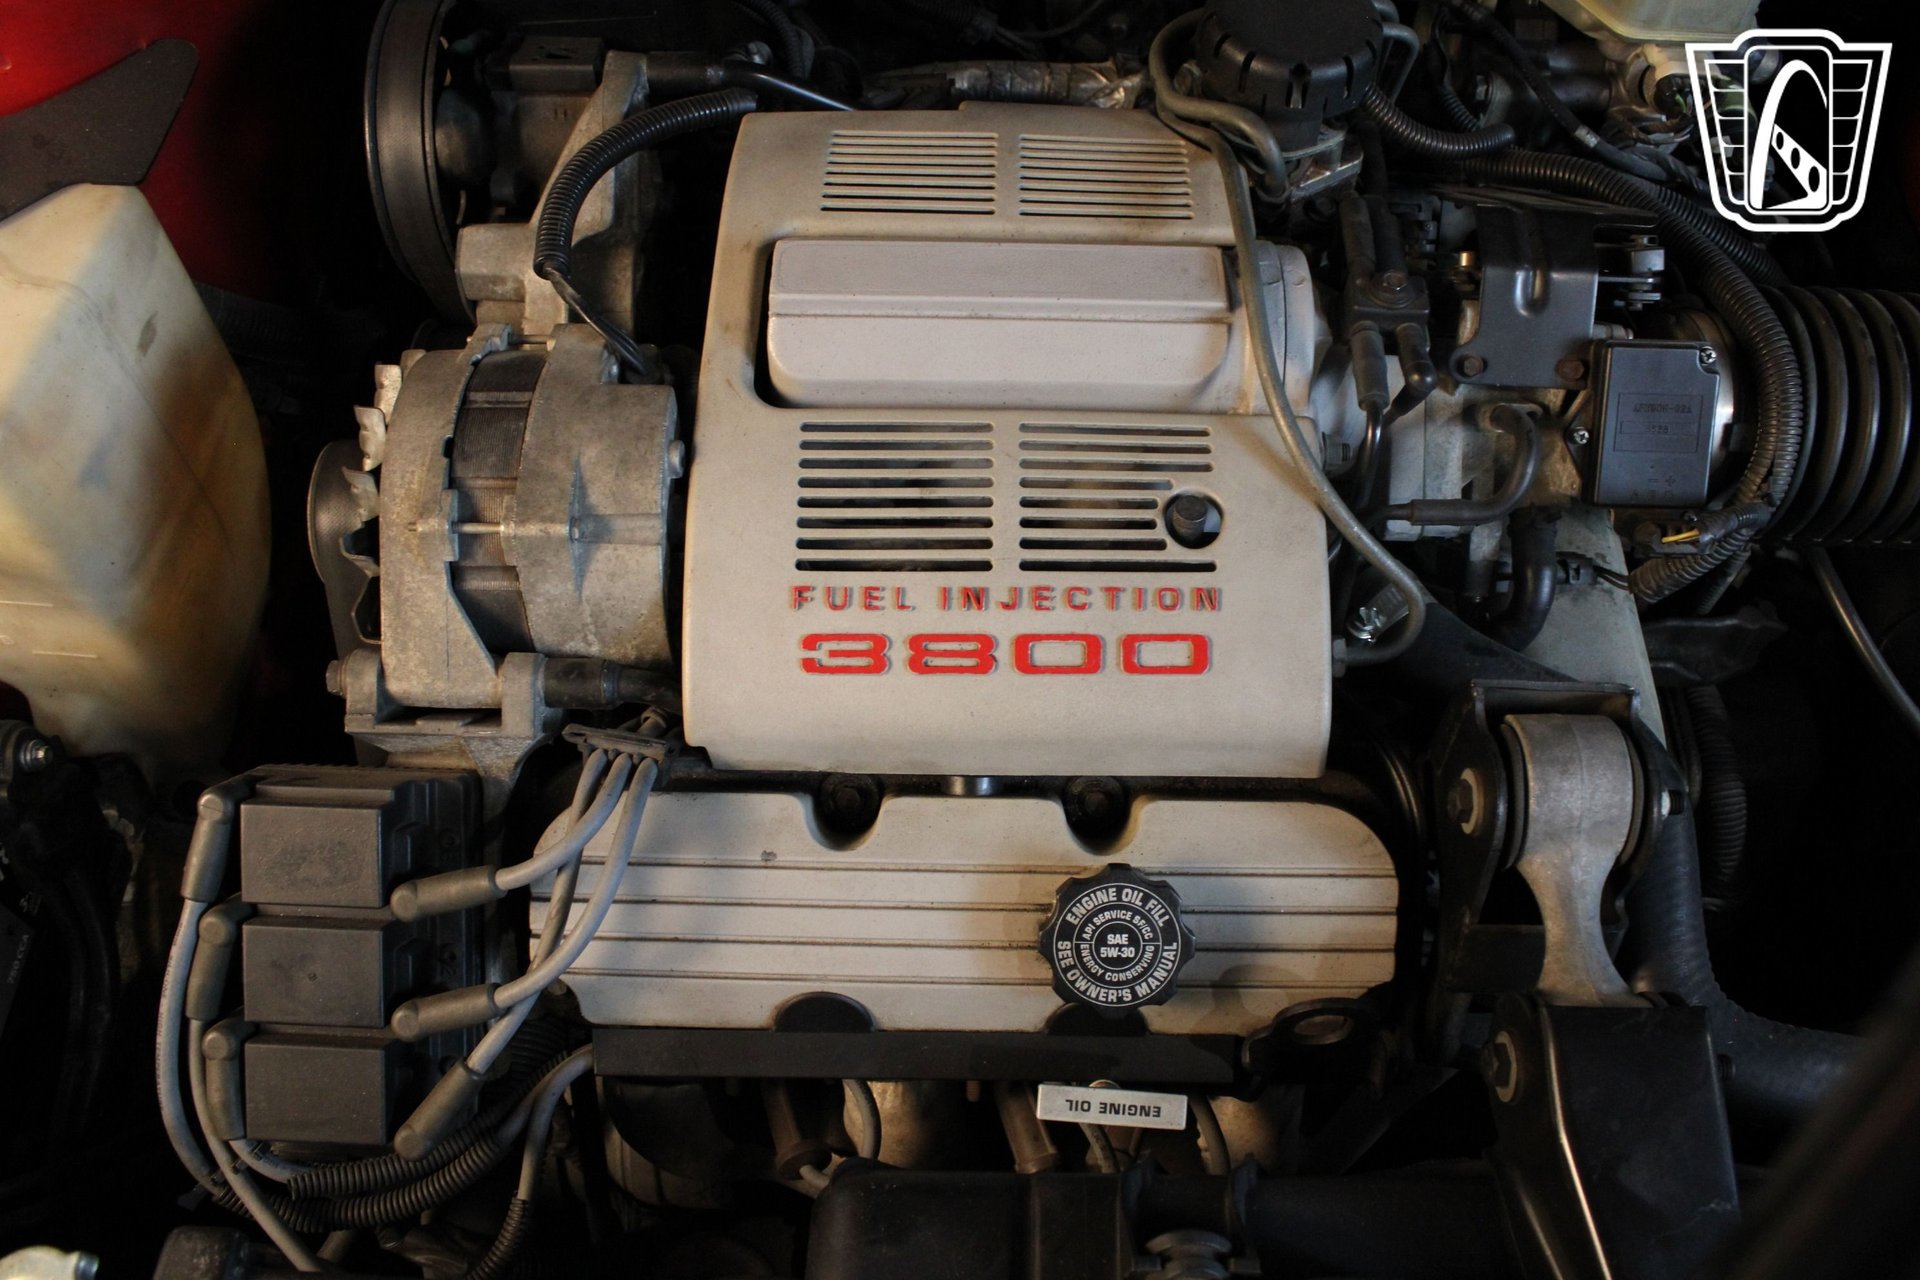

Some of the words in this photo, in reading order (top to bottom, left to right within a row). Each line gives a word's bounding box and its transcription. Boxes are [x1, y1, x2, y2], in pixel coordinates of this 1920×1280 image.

[790, 585, 917, 612] FUEL
[938, 585, 1222, 612] INJECTION
[798, 633, 1212, 676] 3800
[1065, 887, 1118, 926] ENGINE
[1121, 888, 1143, 906] OIL
[1145, 899, 1170, 927] FILL
[1082, 920, 1095, 941] API
[1094, 909, 1131, 926] SERVICE
[1107, 933, 1129, 945] SAE
[1080, 944, 1105, 977] ENERGY
[1105, 945, 1155, 982] CONSERVING
[1099, 946, 1136, 958] 5W-30
[1057, 940, 1074, 968] SEE
[1067, 968, 1133, 1003] OWNER'S
[1134, 942, 1178, 998] MANUAL
[1065, 1099, 1092, 1112] OIL
[1098, 1101, 1162, 1118] ENGINE
